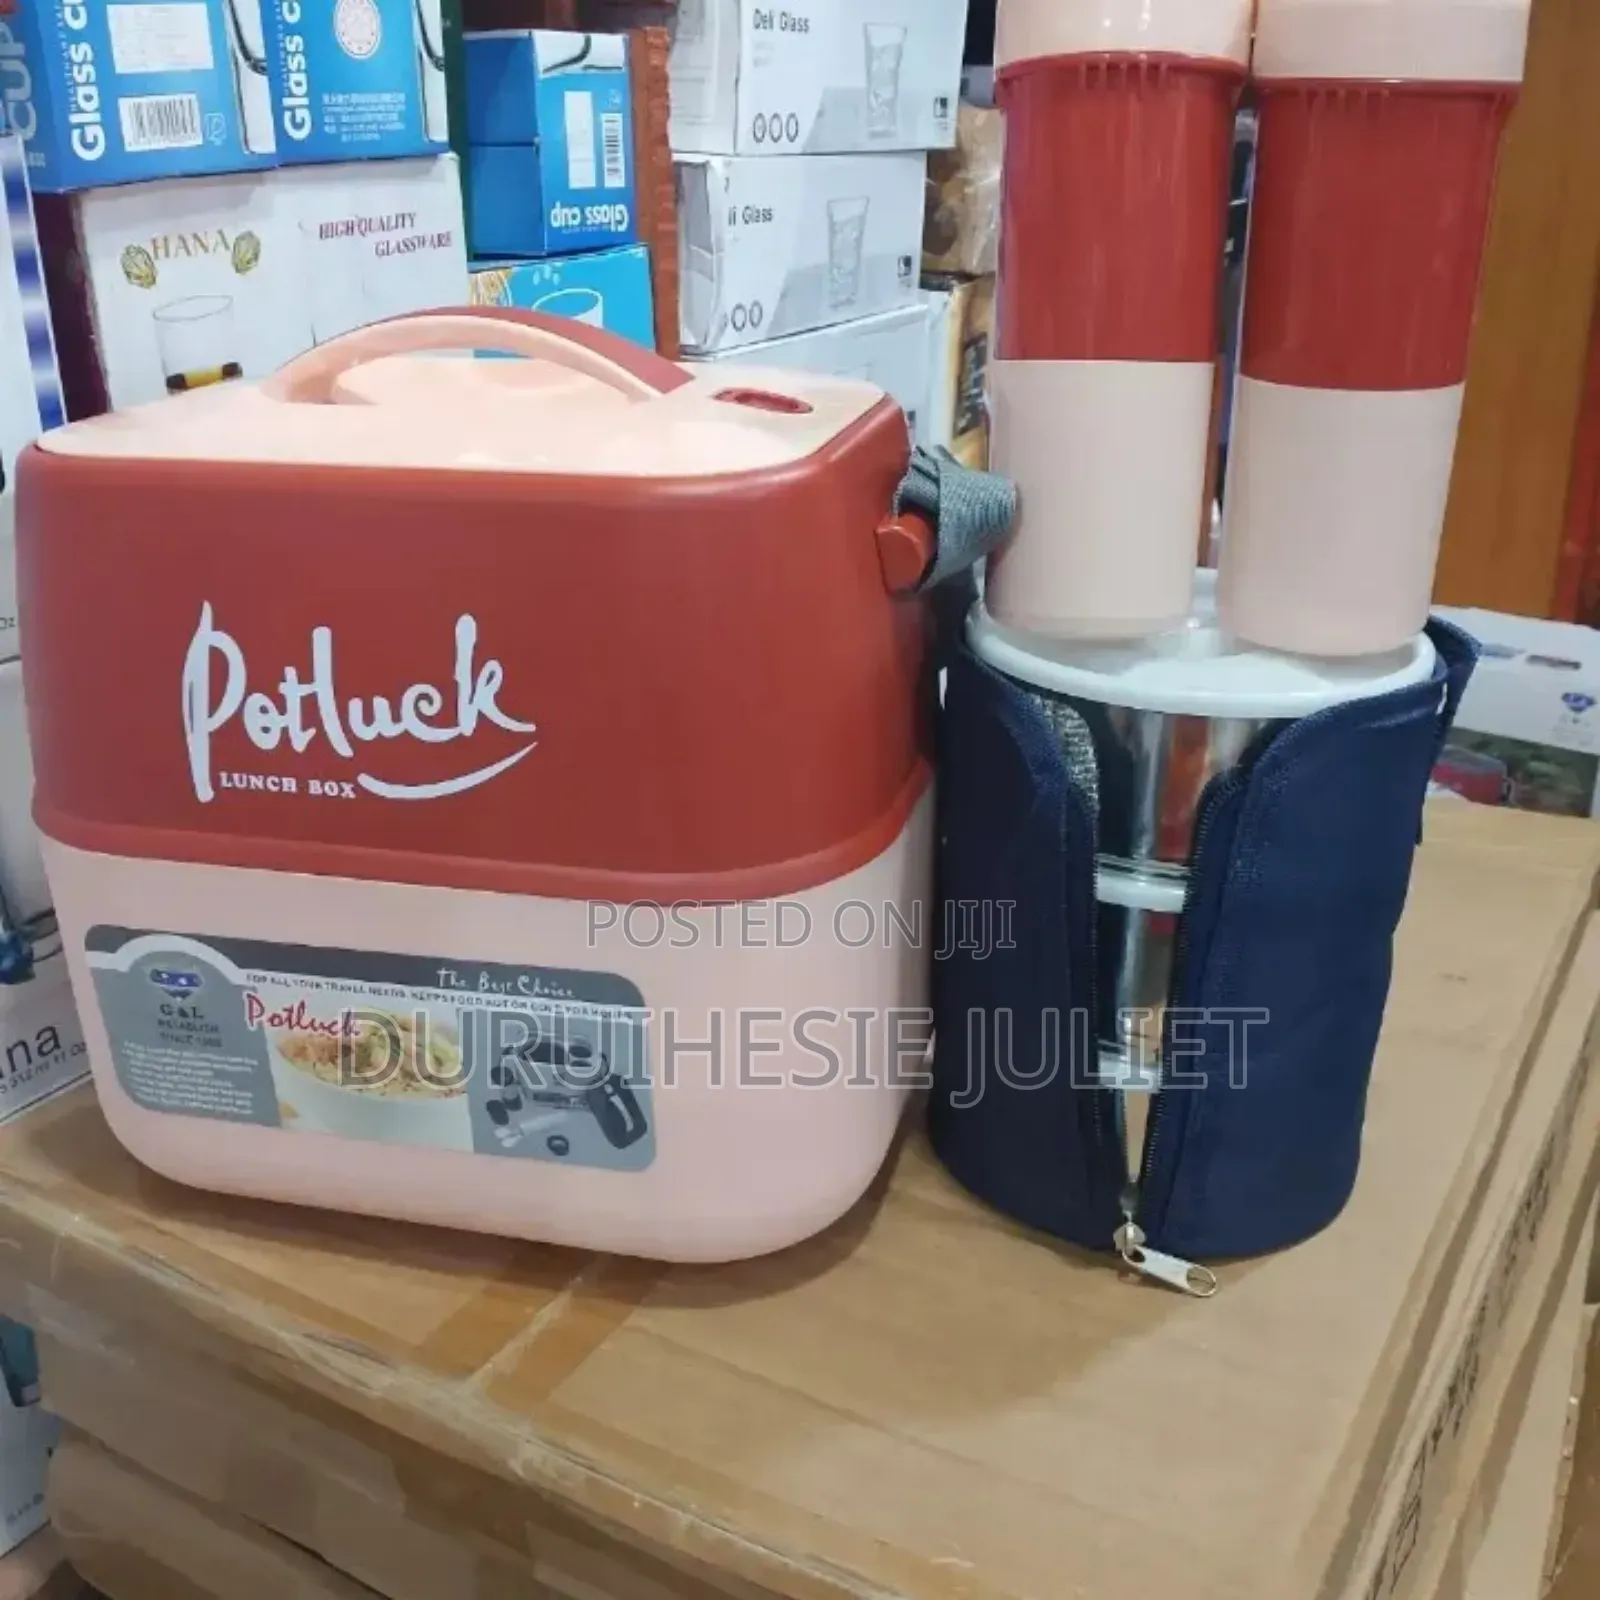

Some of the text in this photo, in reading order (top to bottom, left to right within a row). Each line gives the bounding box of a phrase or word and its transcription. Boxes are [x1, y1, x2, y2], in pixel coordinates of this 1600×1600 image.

[753, 8, 810, 33] Deli Glass
[69, 42, 106, 161] Glass
[282, 35, 312, 141] Glass
[318, 212, 417, 240] HIGH QUALITY
[551, 201, 630, 232] Glass cup
[742, 205, 773, 225] Glass
[151, 228, 232, 262] HANA
[374, 231, 453, 258] GLASSWARE
[182, 600, 537, 803] Potluck
[219, 771, 356, 799] LUNCH BOX
[245, 991, 362, 1038] Potluck
[0, 1025, 61, 1079] na
